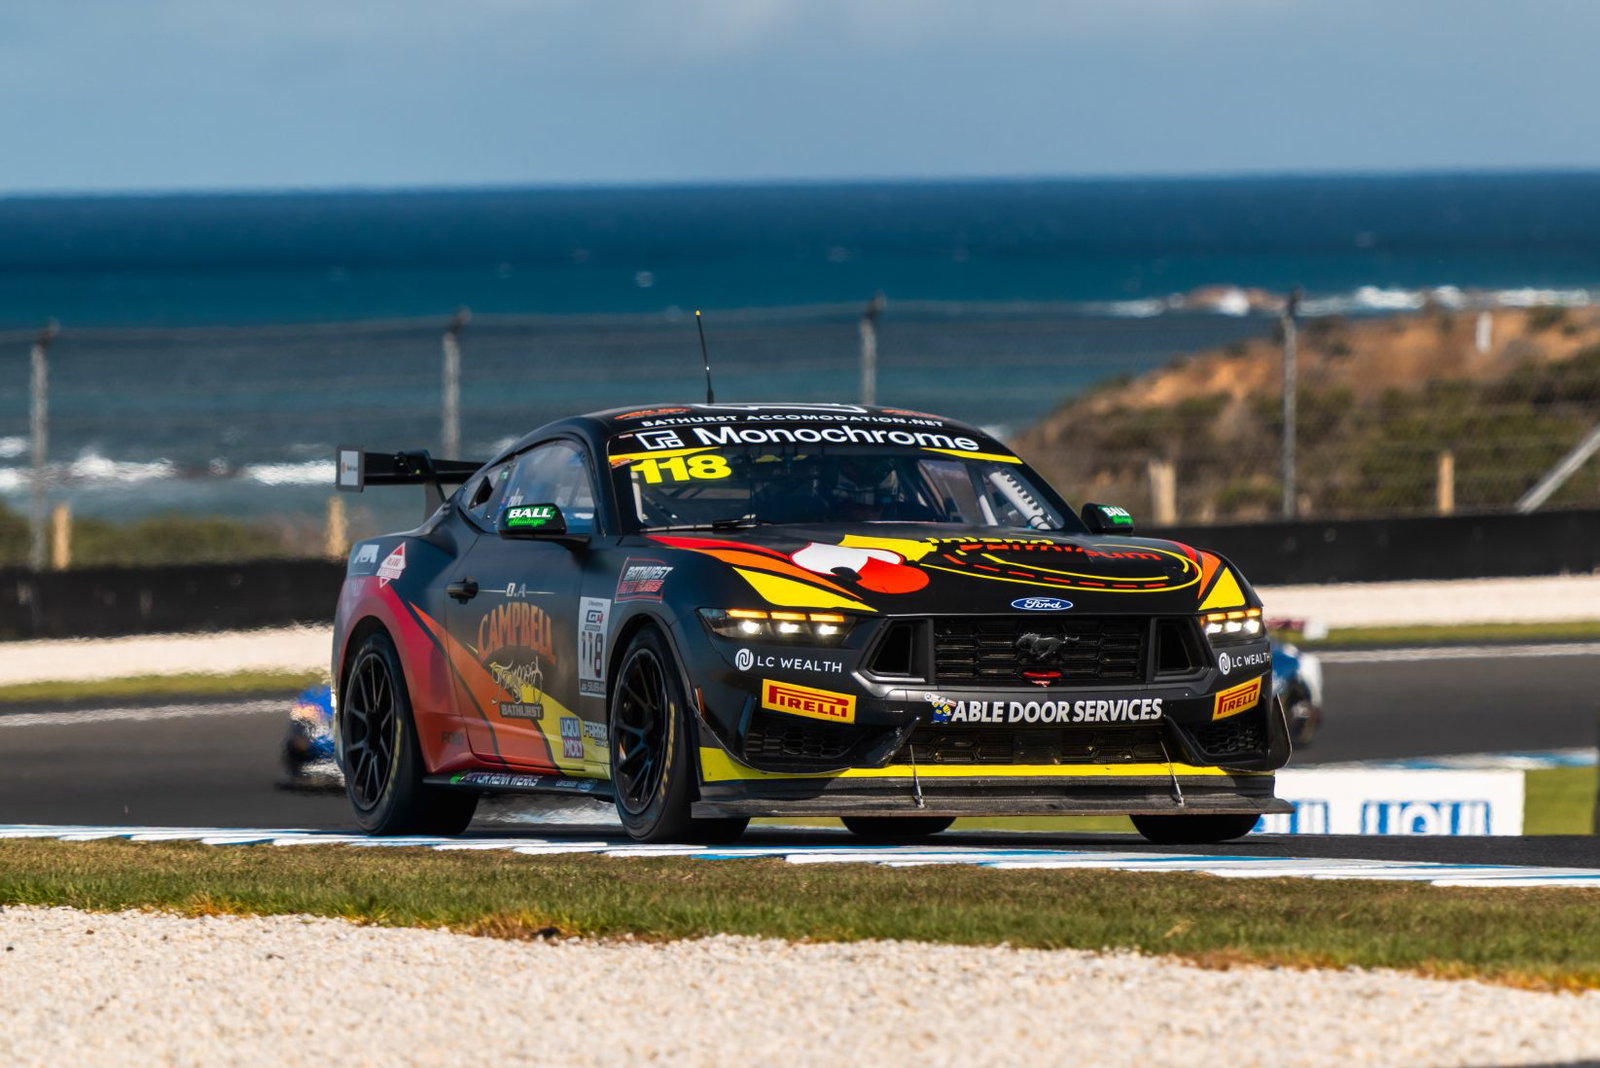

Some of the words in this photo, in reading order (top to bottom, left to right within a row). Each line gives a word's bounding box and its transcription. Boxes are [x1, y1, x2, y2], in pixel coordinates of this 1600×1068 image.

[641, 415, 737, 428] BATHURST
[746, 414, 944, 428] ACCOMODATION.NET
[692, 425, 980, 451] Monochrome
[630, 454, 732, 485] 118
[508, 507, 551, 519] BALL
[1023, 598, 1062, 610] Ford
[478, 601, 556, 666] CAMPBELL
[757, 656, 775, 668] LC
[780, 657, 843, 673] WEALTH
[1231, 656, 1243, 668] LC
[768, 684, 850, 718] PIRELLI
[1216, 683, 1259, 715] PIRELLI
[500, 703, 541, 718] BATHURST
[950, 700, 1004, 724] ABLE
[1007, 700, 1071, 724] DOOR
[1072, 698, 1164, 723] SERVICES
